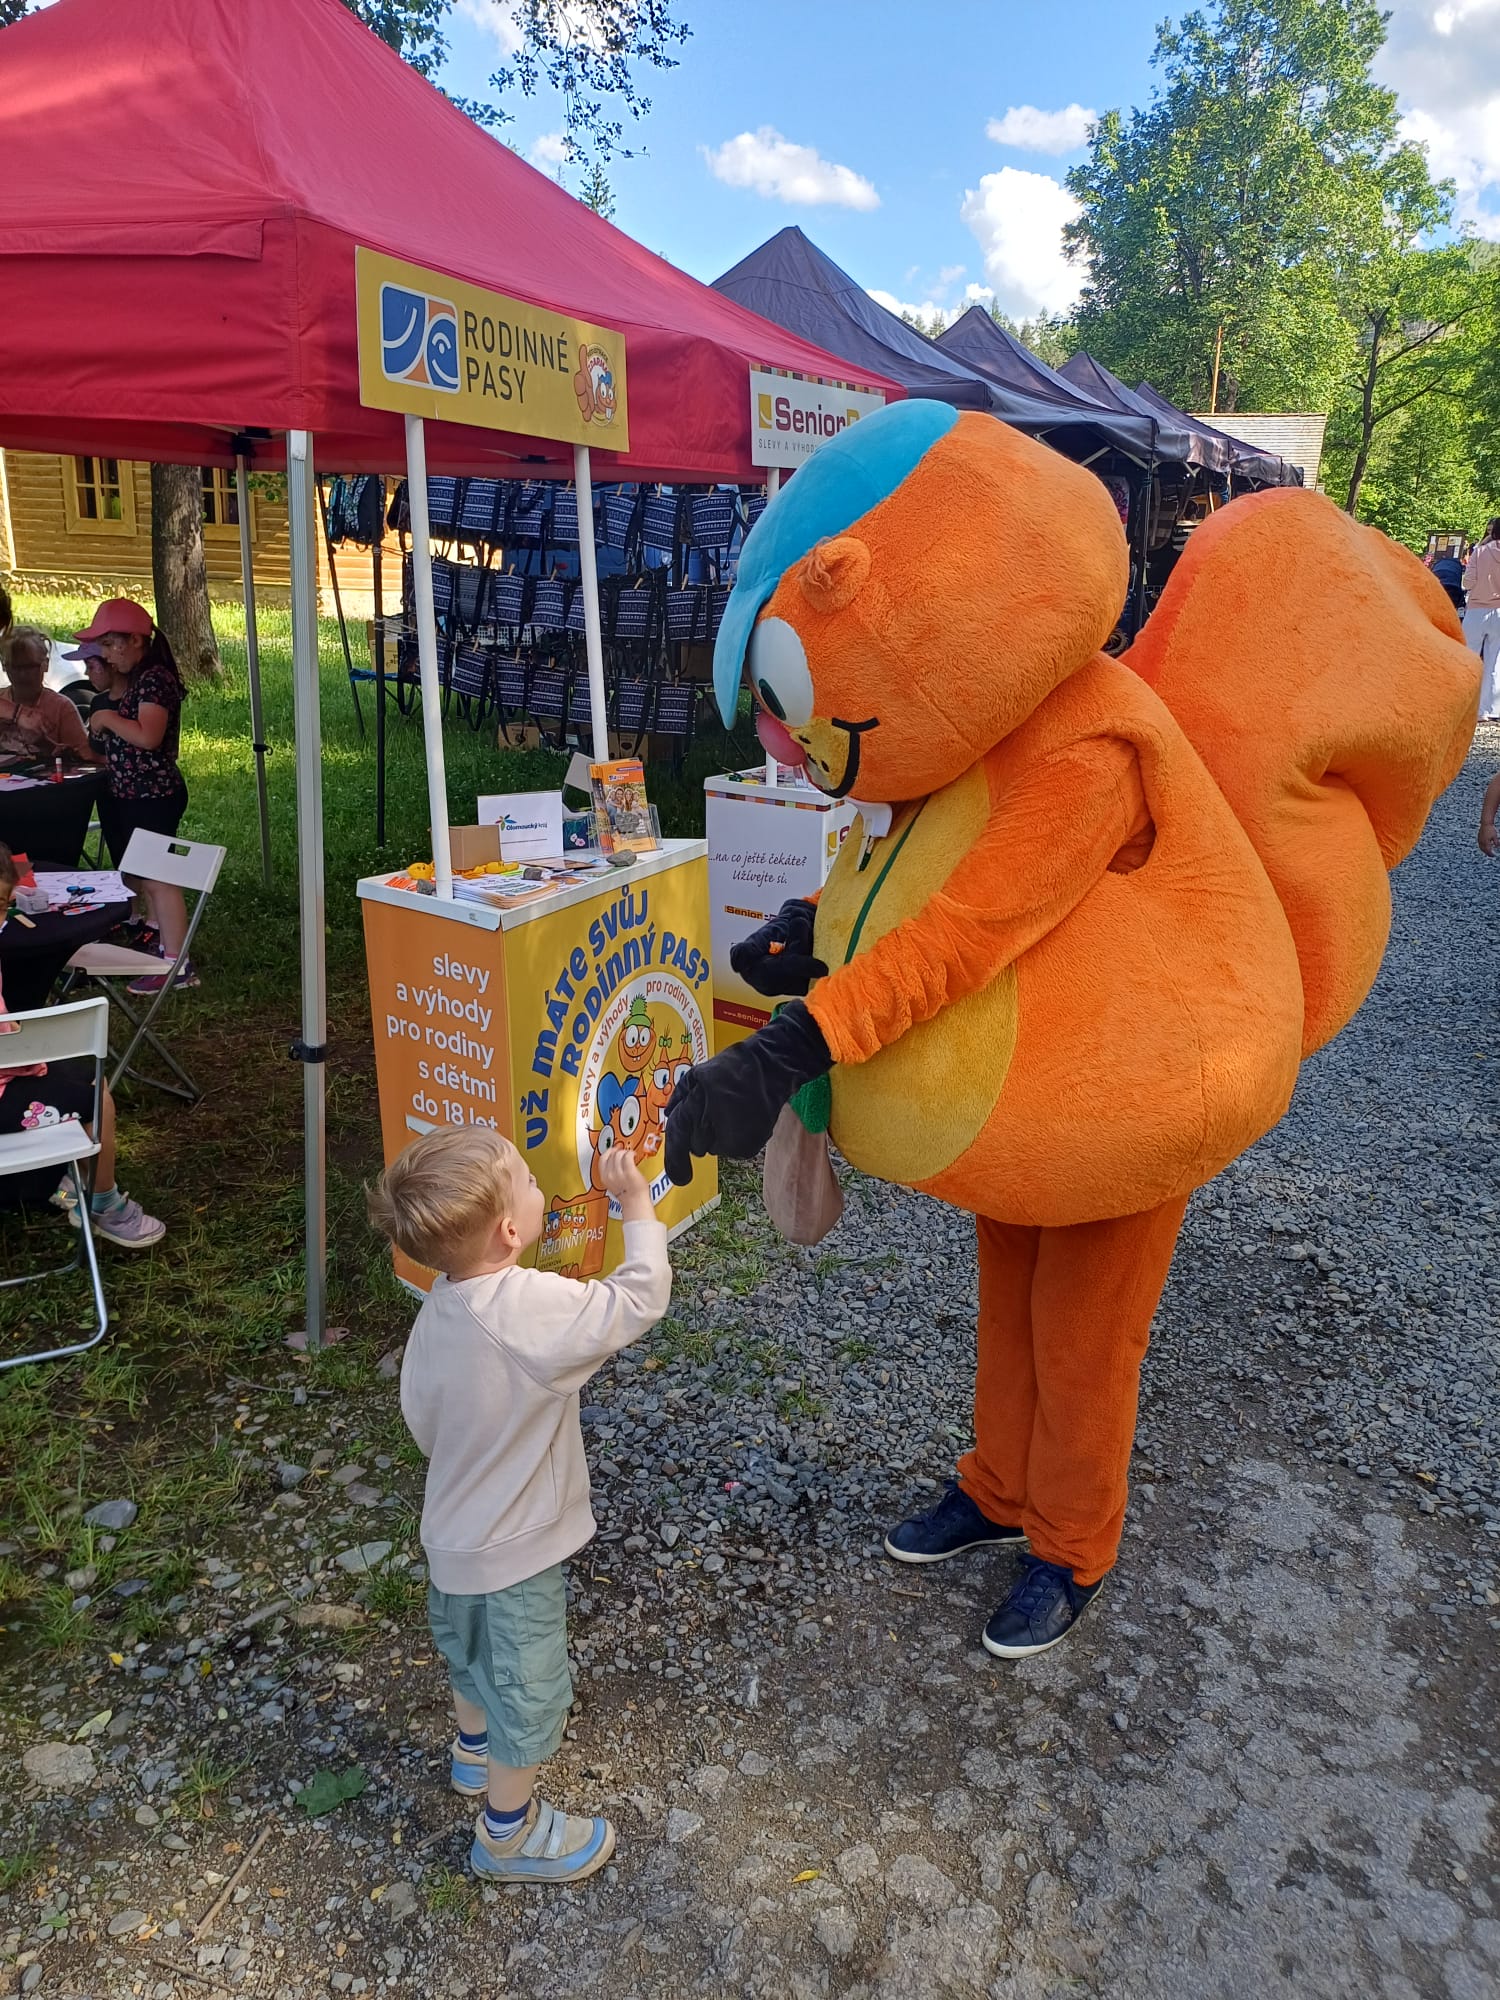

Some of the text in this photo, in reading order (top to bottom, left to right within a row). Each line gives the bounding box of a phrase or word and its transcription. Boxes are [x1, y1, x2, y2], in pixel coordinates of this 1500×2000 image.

[464, 310, 569, 374] RODINNÉ
[466, 356, 526, 404] PASY
[758, 438, 781, 450] SLEVY
[784, 439, 789, 451] A
[731, 853, 742, 863] co
[741, 850, 767, 868] ještě
[768, 852, 808, 867] čekáte?
[732, 869, 775, 888] Užívejte
[432, 952, 491, 994] slevy
[659, 931, 710, 990] PAS?
[396, 982, 493, 1032] a výhody
[386, 1014, 495, 1070] pro rodiny
[580, 980, 706, 1119] slevy a výhody pro rodiny s dětmi
[418, 1060, 497, 1103] s dětmi
[412, 1089, 439, 1117] do
[442, 1099, 465, 1127] 18
[585, 1225, 604, 1244] PAS
